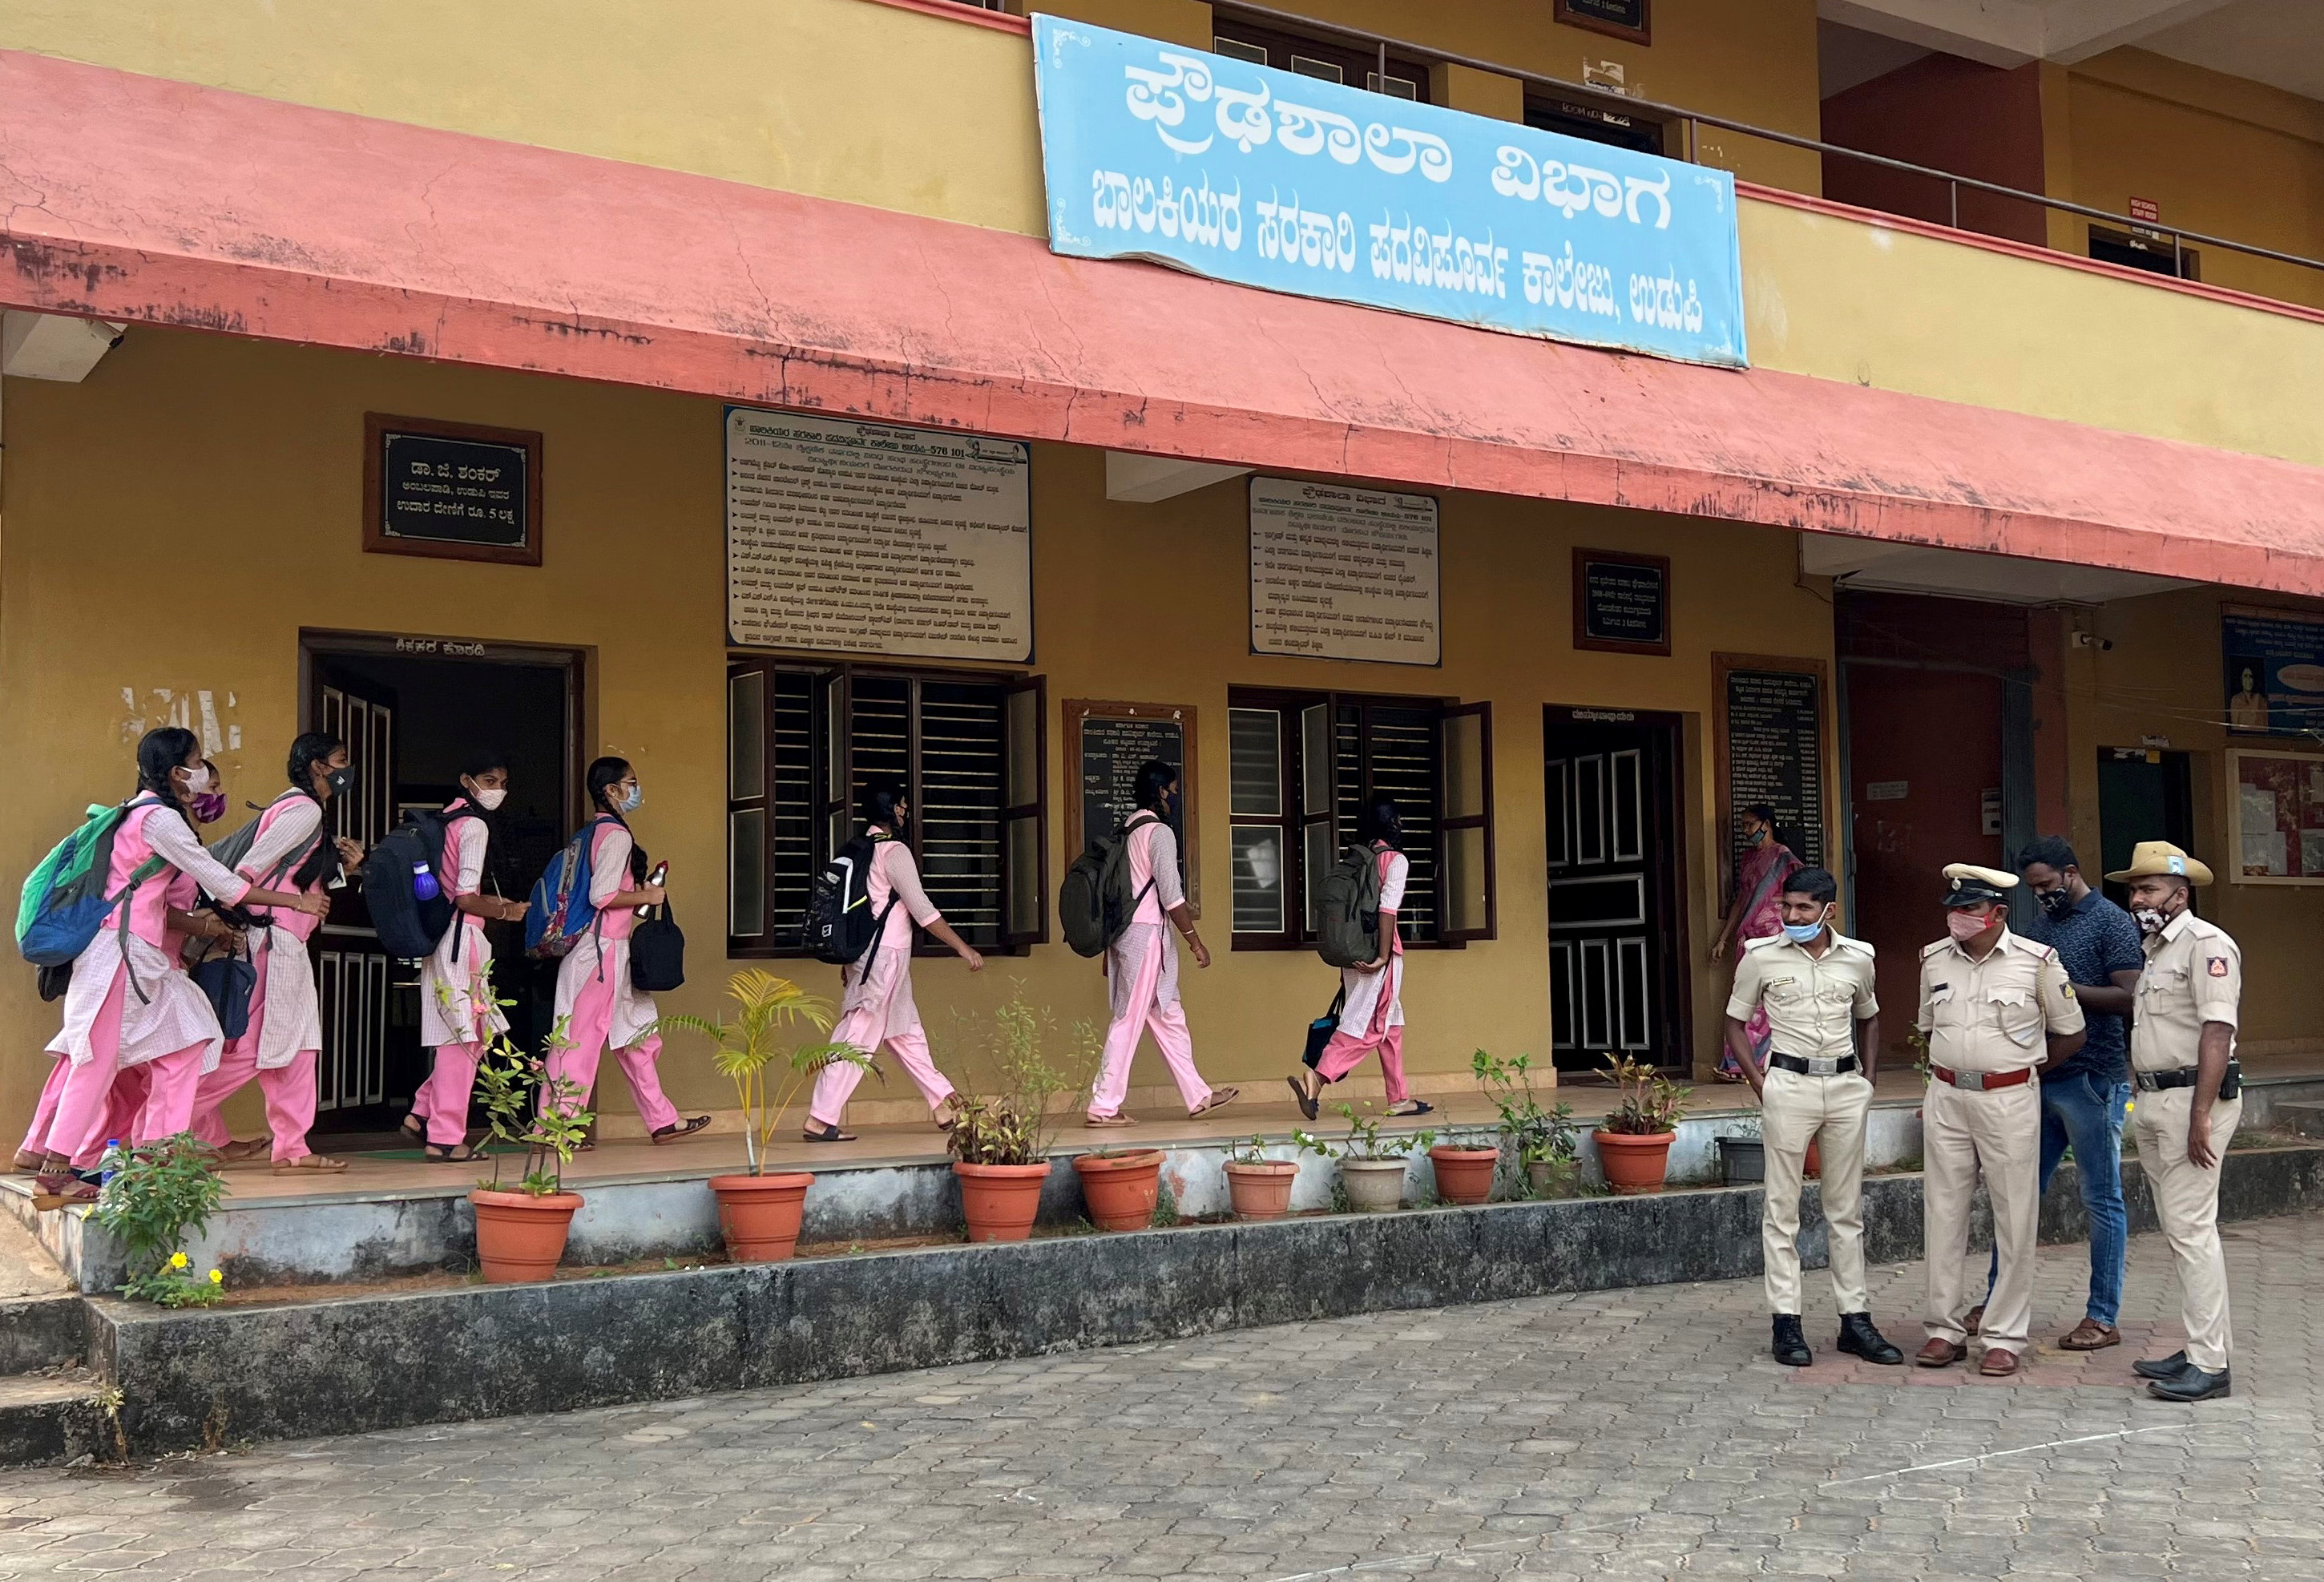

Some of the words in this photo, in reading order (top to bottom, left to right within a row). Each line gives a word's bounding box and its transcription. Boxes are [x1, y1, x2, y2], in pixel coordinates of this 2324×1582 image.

[1124, 51, 1453, 184] ಪ್ರೌಢಶಾಲಾ
[1490, 144, 1670, 230] ವಿಭಾಗ
[1091, 167, 1242, 250] ಬಾಲಕಿಯರ
[1257, 184, 1356, 272] ಸರಕಾರಿ
[1370, 206, 1508, 298] ಪದವಿಪೂರ್ವ
[1629, 270, 1703, 334] ಉಡುಪಿ
[950, 447, 964, 458] 101
[458, 464, 501, 482] ಶಂಕರ್
[490, 508, 496, 519] 5
